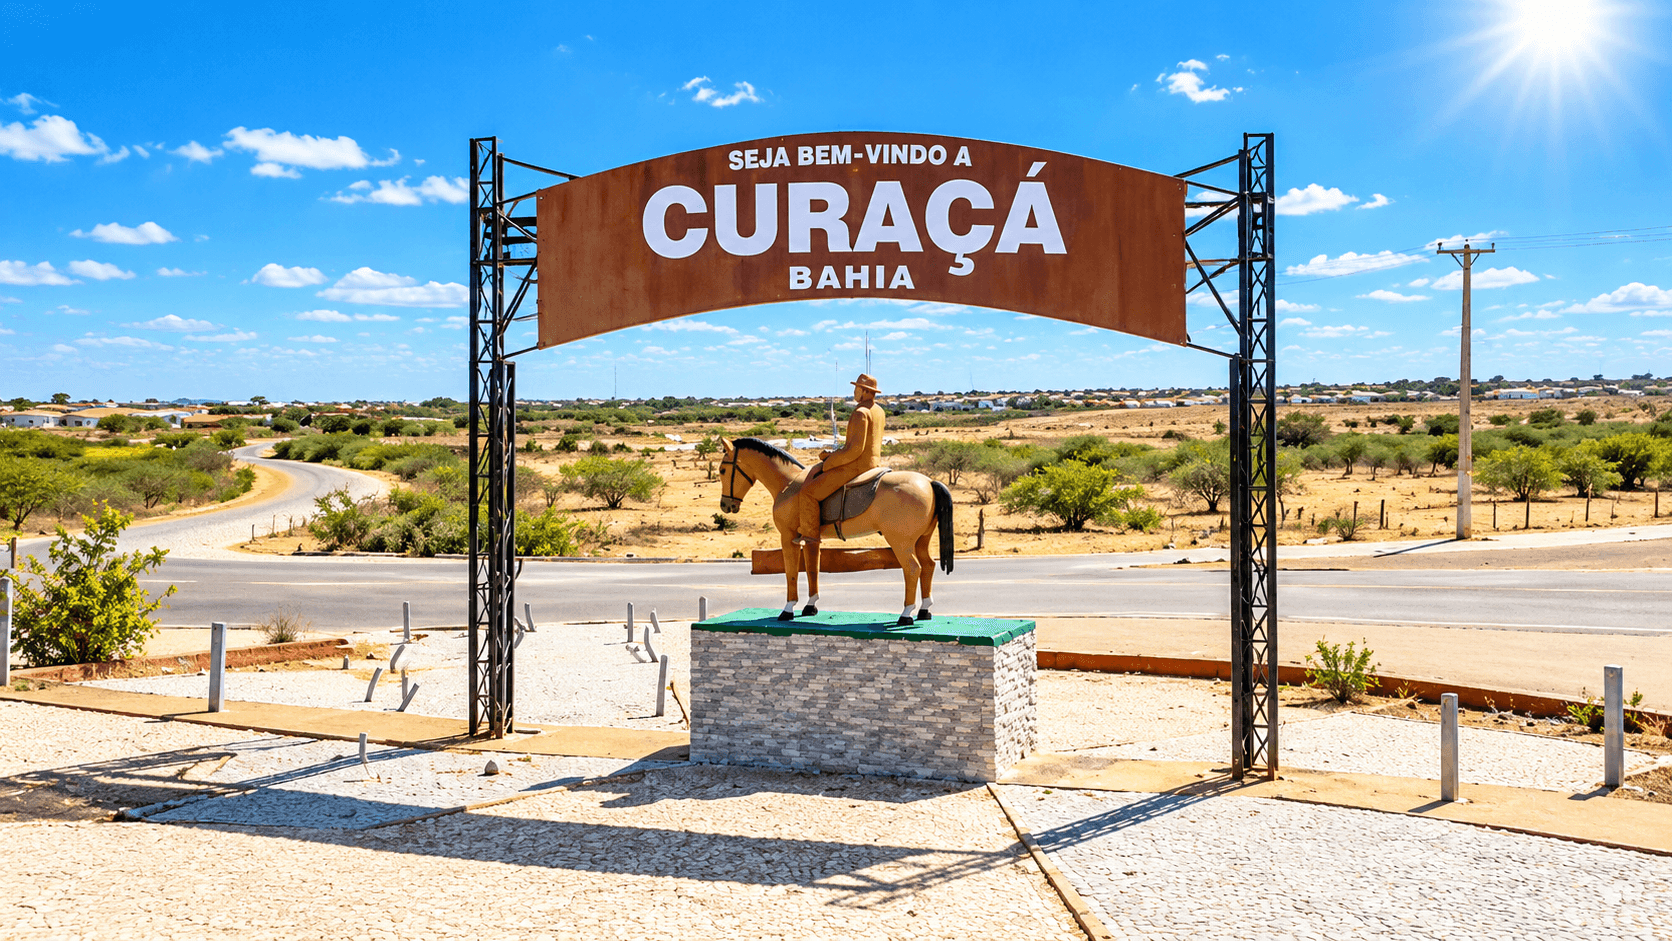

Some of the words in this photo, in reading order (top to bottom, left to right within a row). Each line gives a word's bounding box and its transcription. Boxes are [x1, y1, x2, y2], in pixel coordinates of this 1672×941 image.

[728, 146, 790, 171] SEJA
[797, 144, 947, 166] BEM-VINDO
[953, 145, 972, 167] A
[642, 161, 1068, 276] CURAÇÁ
[789, 265, 915, 290] BAHIA
